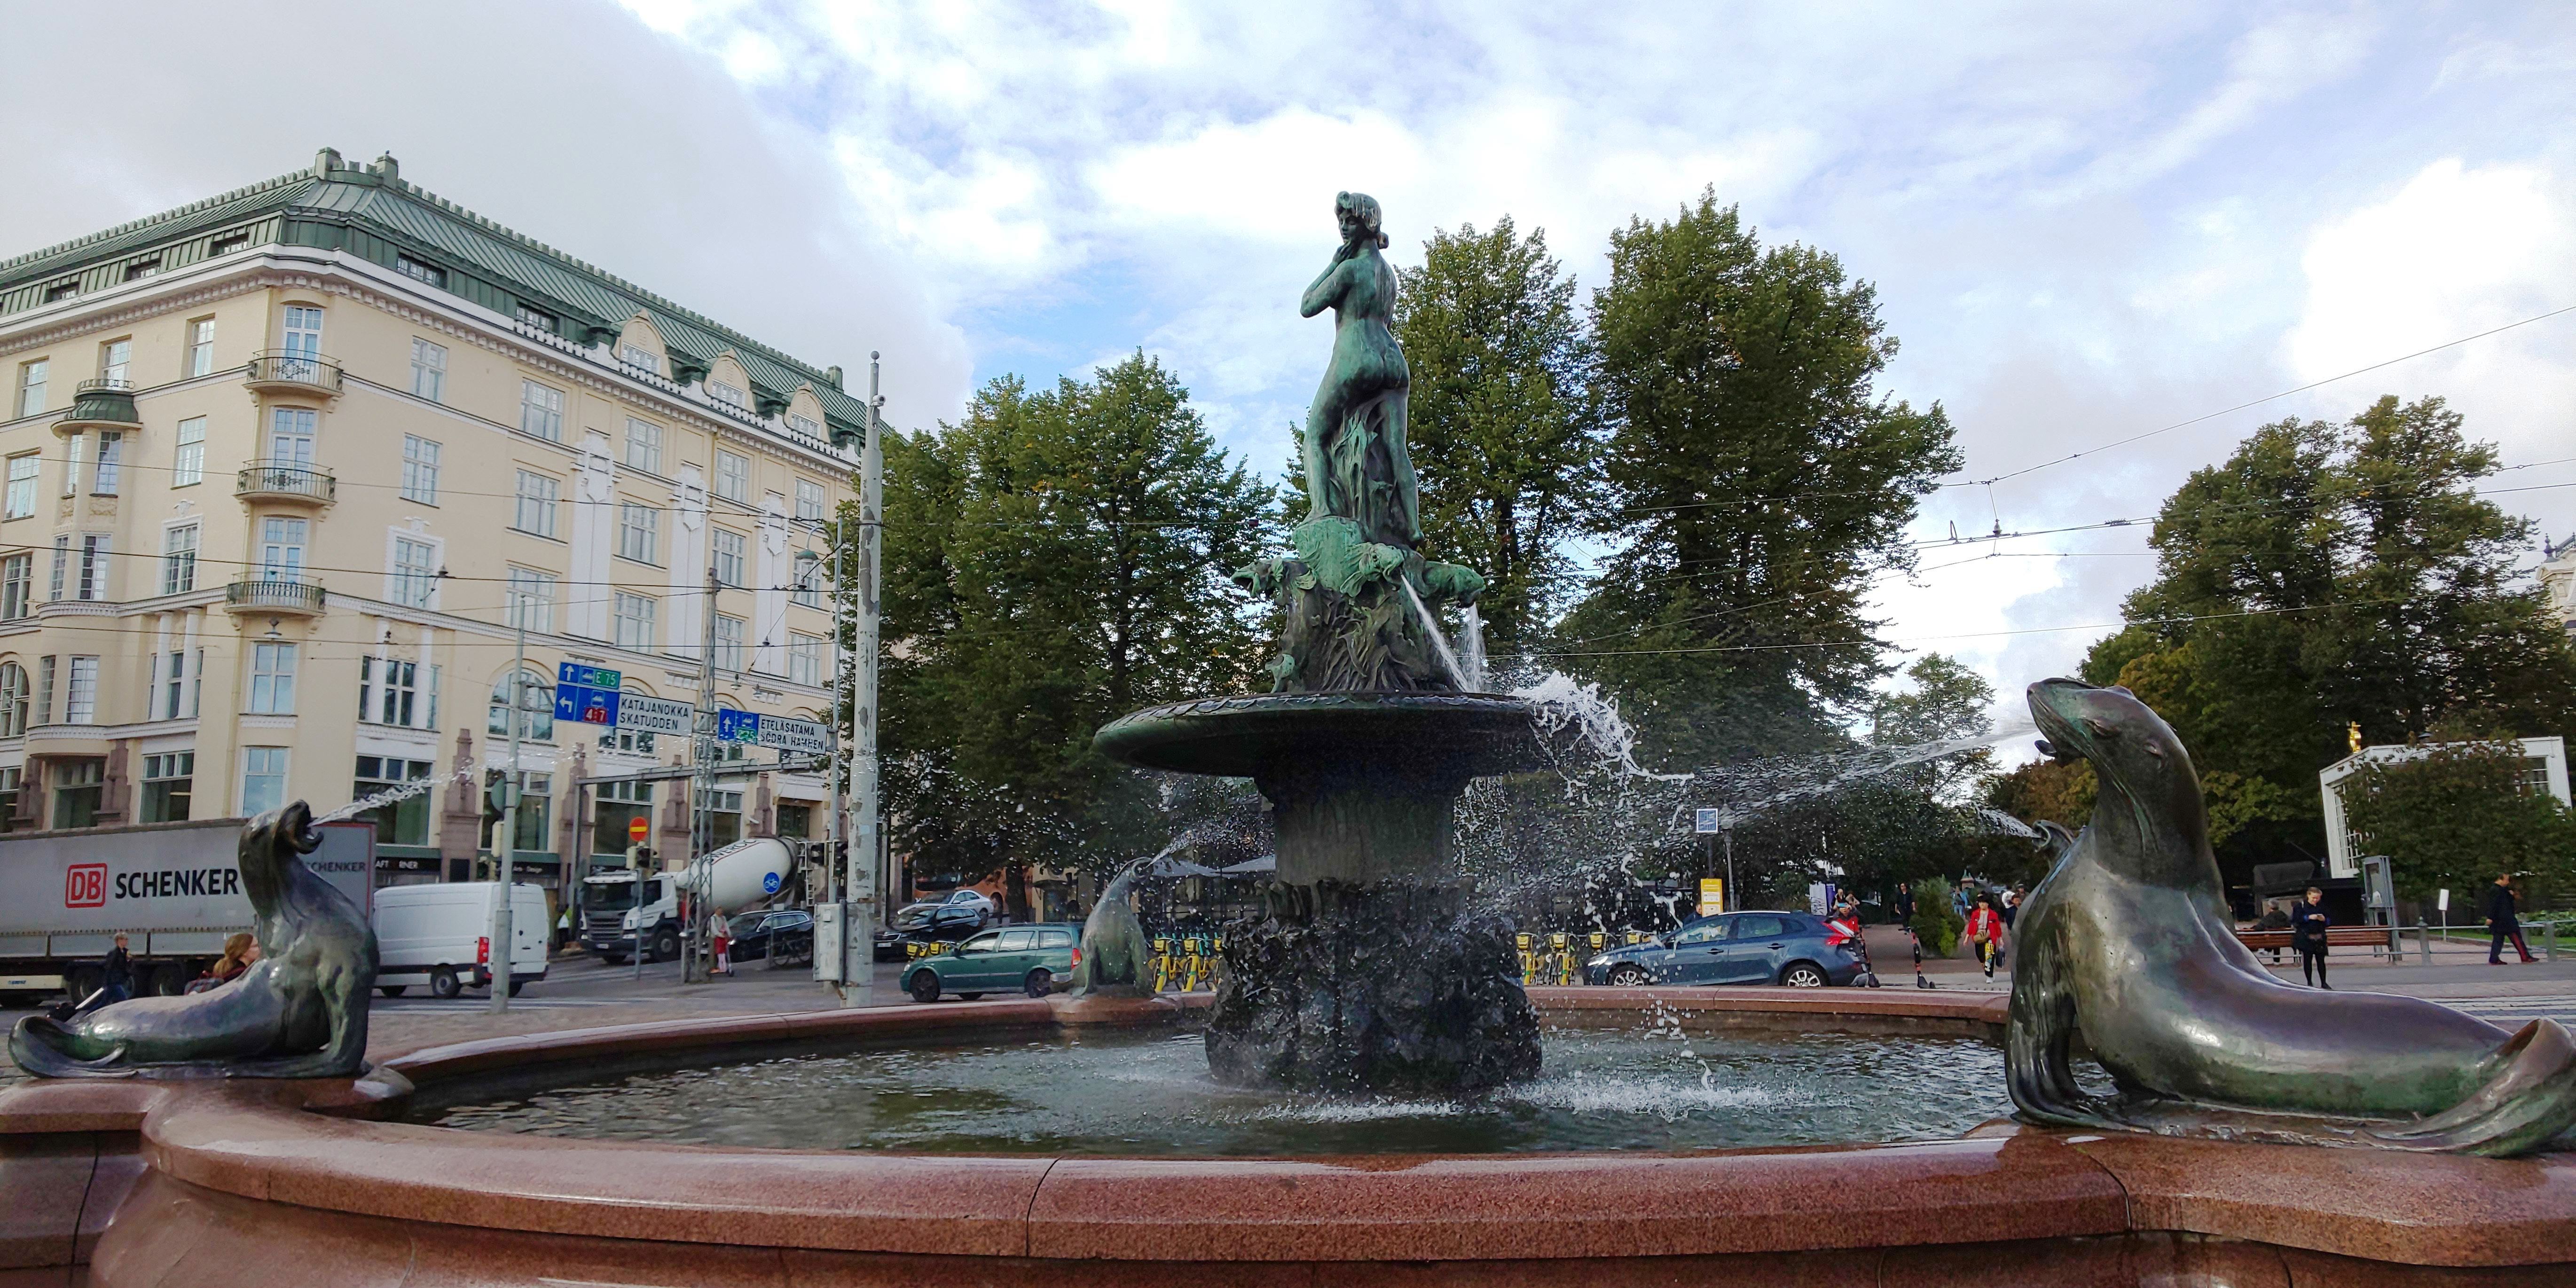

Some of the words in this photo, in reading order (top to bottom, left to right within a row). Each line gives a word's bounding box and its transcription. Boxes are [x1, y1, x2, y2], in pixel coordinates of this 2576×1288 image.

[596, 672, 602, 683] E
[605, 673, 616, 686] 75
[621, 698, 689, 718] KATAJANOKKA
[620, 712, 678, 730] SKATUDDEN
[761, 719, 815, 736] ETELÄSATAMA
[761, 731, 786, 745] SÖDRA
[375, 860, 389, 868] AFT
[71, 871, 102, 901] DB
[115, 868, 239, 899] SCHENKER
